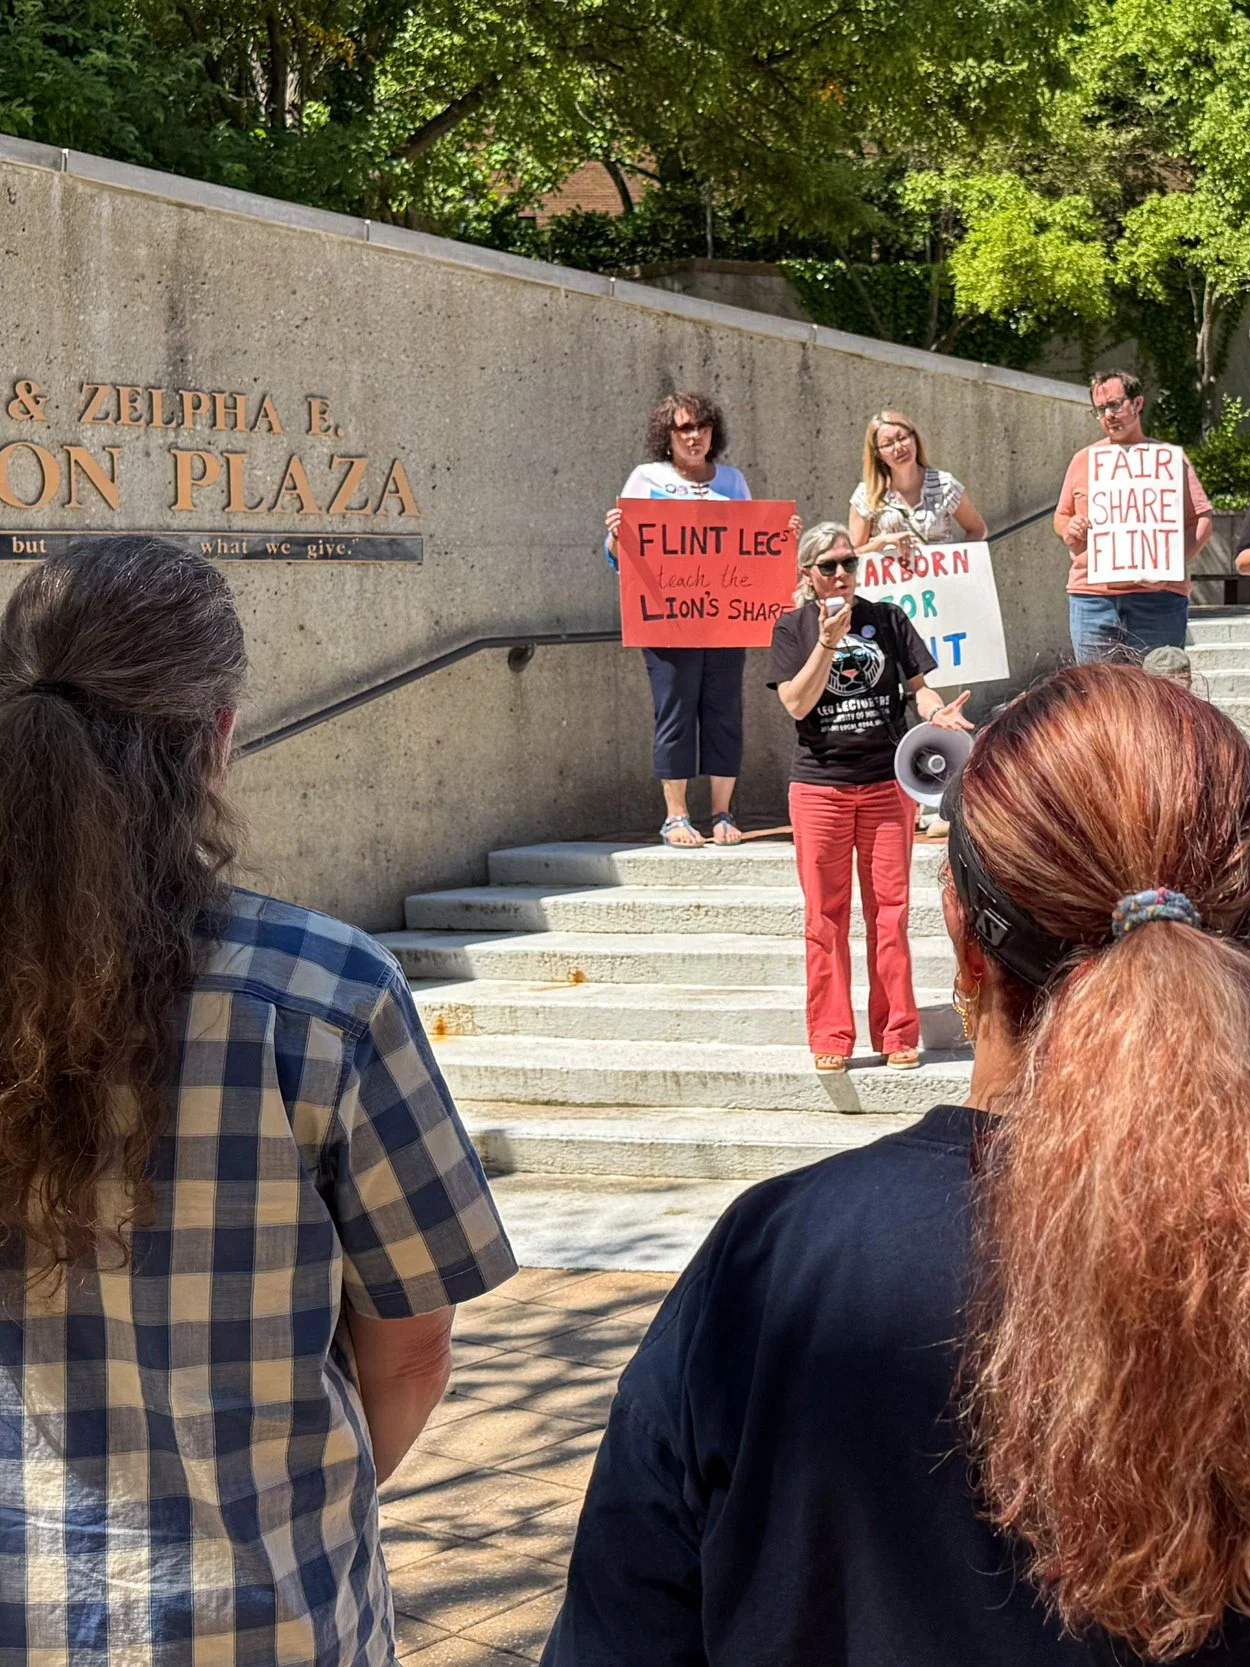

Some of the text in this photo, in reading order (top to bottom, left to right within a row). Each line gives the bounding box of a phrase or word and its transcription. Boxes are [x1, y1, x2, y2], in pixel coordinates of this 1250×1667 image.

[8, 380, 345, 438] & ZELPHA E.
[0, 442, 421, 517] ON PLAZA
[1093, 448, 1174, 481] FAIR
[1092, 488, 1177, 525] SHARE
[12, 536, 47, 554] but
[200, 539, 248, 555] what
[266, 542, 291, 555] we
[638, 523, 728, 557] FLINT
[1092, 529, 1179, 573] FLINT
[657, 564, 753, 588] teach the
[880, 590, 938, 620] OR
